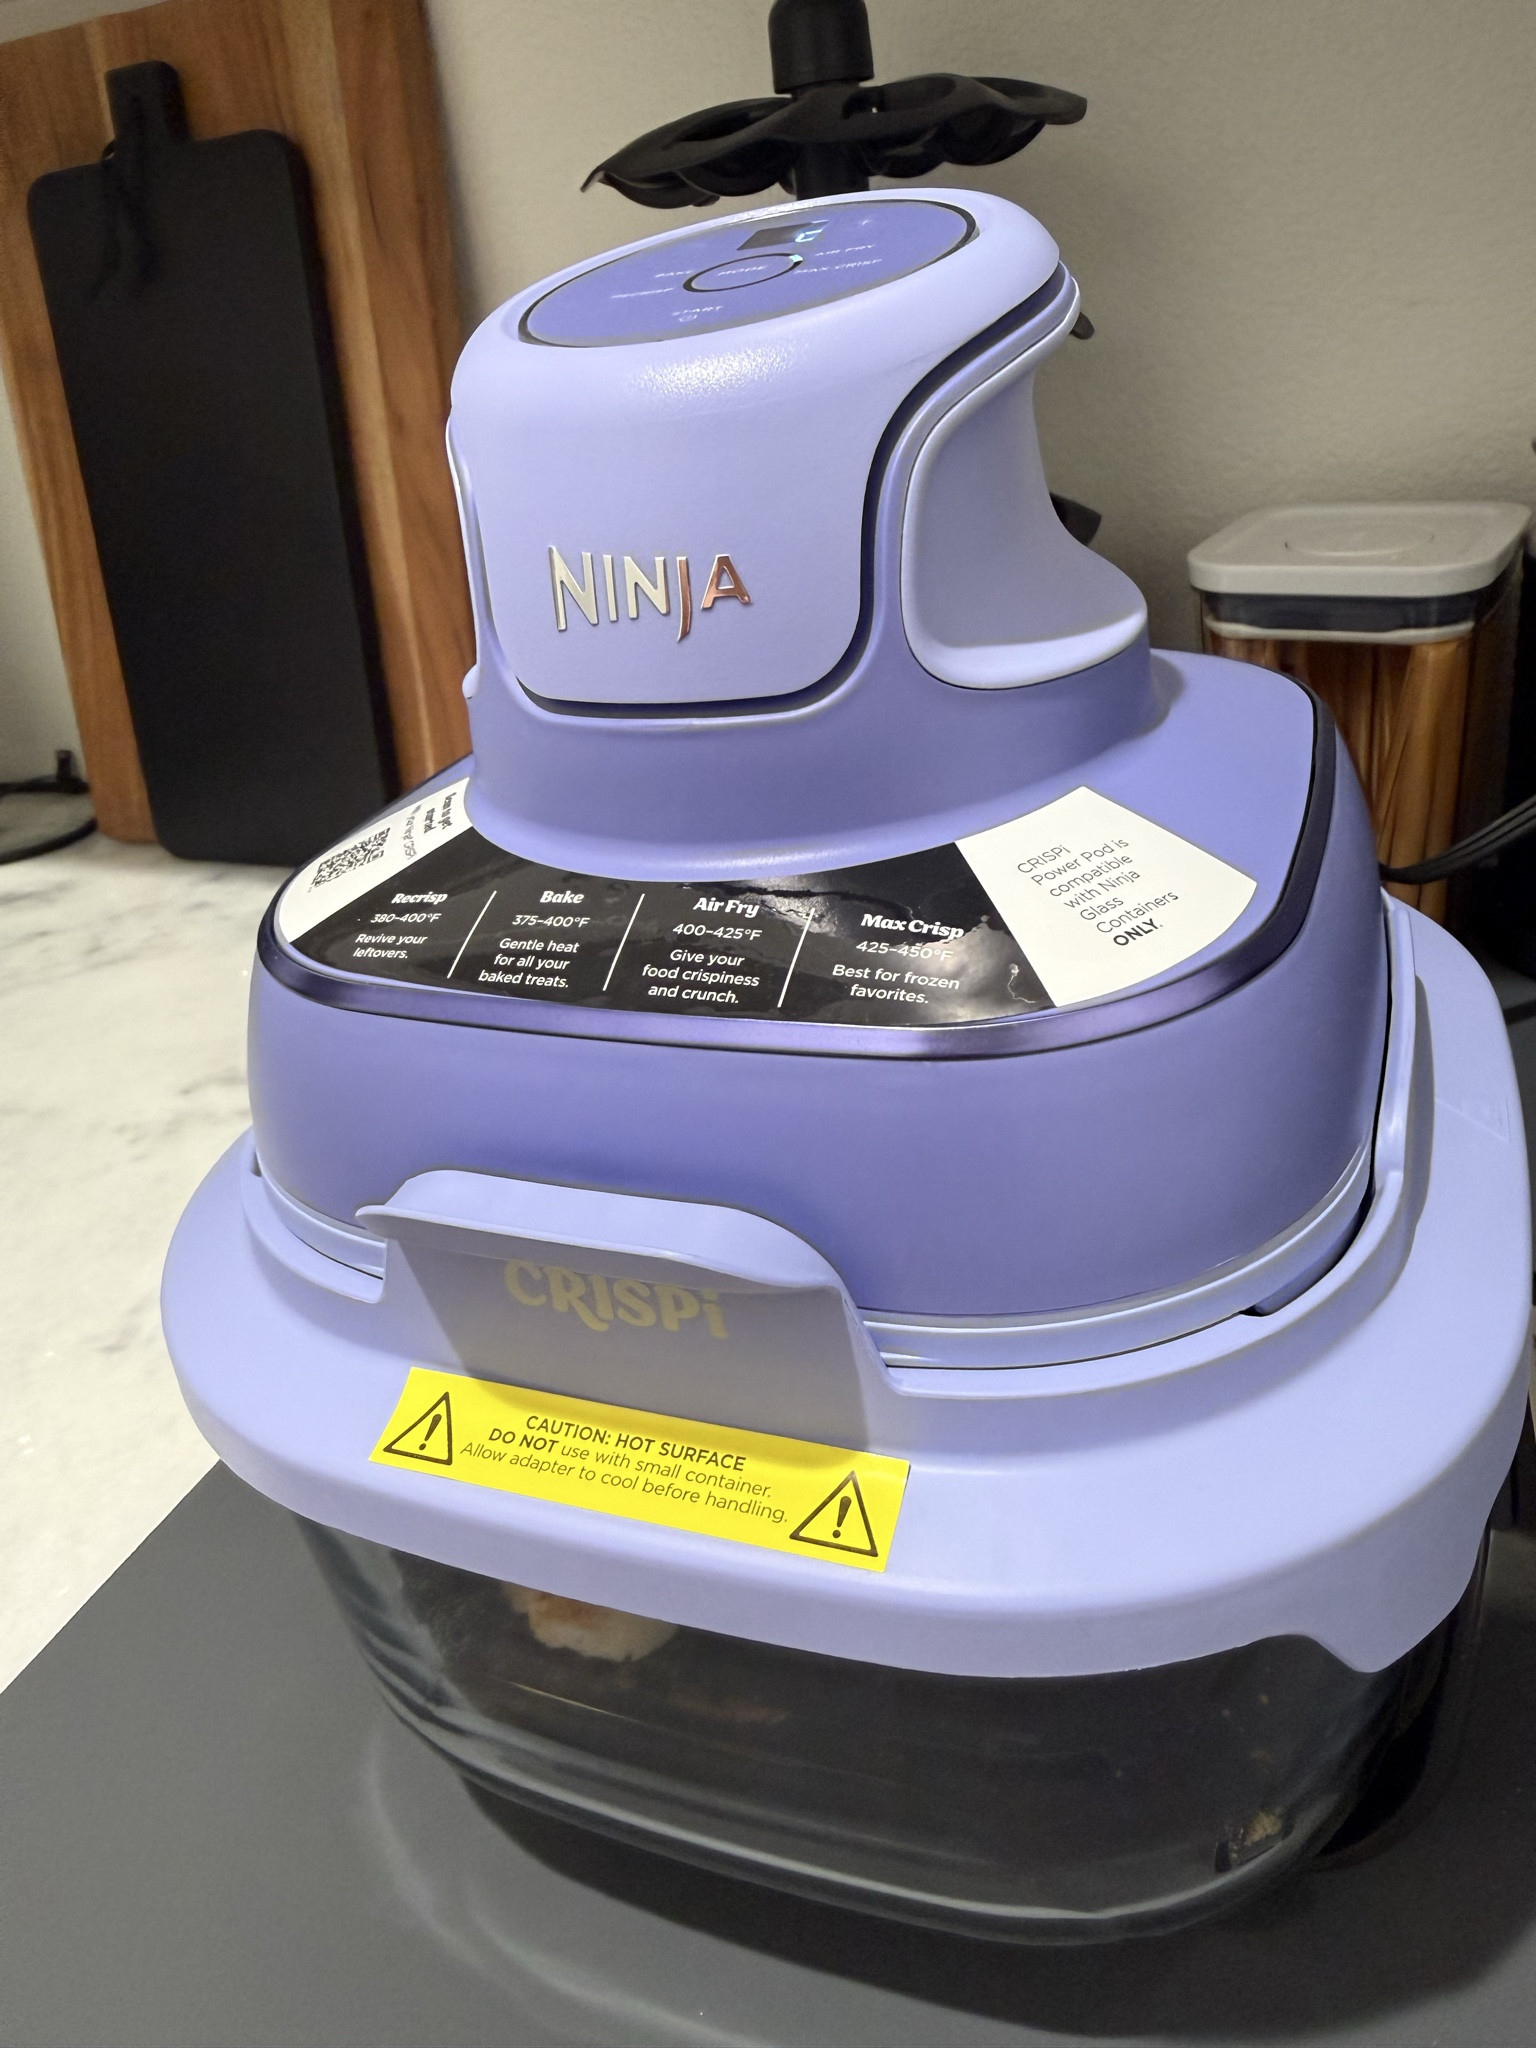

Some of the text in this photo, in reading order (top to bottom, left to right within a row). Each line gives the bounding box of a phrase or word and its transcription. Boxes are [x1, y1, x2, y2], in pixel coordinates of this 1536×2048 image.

[548, 544, 754, 642] NINJA
[1017, 844, 1072, 873] CRISPi
[1031, 838, 1129, 886] Power Pod is
[1049, 854, 1133, 897] compatible
[391, 891, 448, 905] Recrisp
[540, 890, 584, 904] Bake
[1064, 870, 1141, 909] with Ninja
[693, 897, 760, 918] Air Fry
[1080, 897, 1124, 921] Glass
[1096, 891, 1179, 933] Containers
[861, 913, 965, 940] Max Crisp
[355, 933, 428, 945] Revive your
[499, 938, 579, 953] Gentle heat
[353, 947, 408, 959] leftovers.
[494, 953, 570, 971] for all your
[670, 949, 745, 967] Give your
[478, 969, 569, 988] baked treats.
[642, 964, 760, 987] food crispiness
[832, 964, 960, 989] Best for frozen
[648, 985, 739, 1004] and crunch.
[850, 984, 929, 1004] favorites.
[526, 1415, 746, 1471] CAUTION: HOT SURFACE
[488, 1428, 772, 1498] DO NOT use with small container.
[460, 1442, 788, 1523] Allow adapter to cool before handling.
